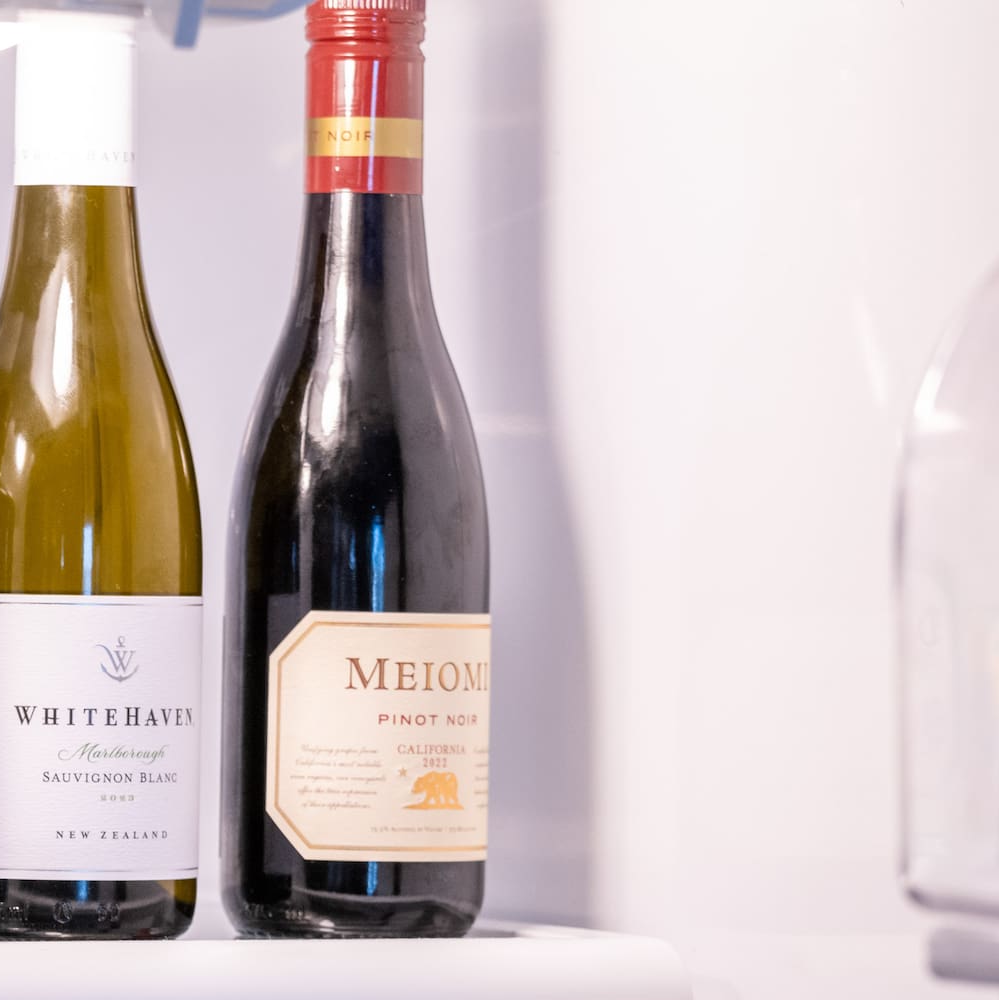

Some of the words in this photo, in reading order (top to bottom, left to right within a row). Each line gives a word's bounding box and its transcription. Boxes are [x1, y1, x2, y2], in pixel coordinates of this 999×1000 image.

[327, 130, 373, 141] NOIR
[14, 705, 194, 726] WHITEHAVEN
[378, 714, 439, 726] PINOT
[446, 714, 478, 726] NOIR
[57, 743, 169, 765] Marlborough
[397, 743, 467, 755] CALIFORNIA
[422, 757, 447, 768] 2022
[42, 770, 133, 784] SAUVIGNON
[139, 771, 177, 784] BLANC
[55, 830, 91, 839] NEW
[100, 830, 168, 840] ZEALAND
